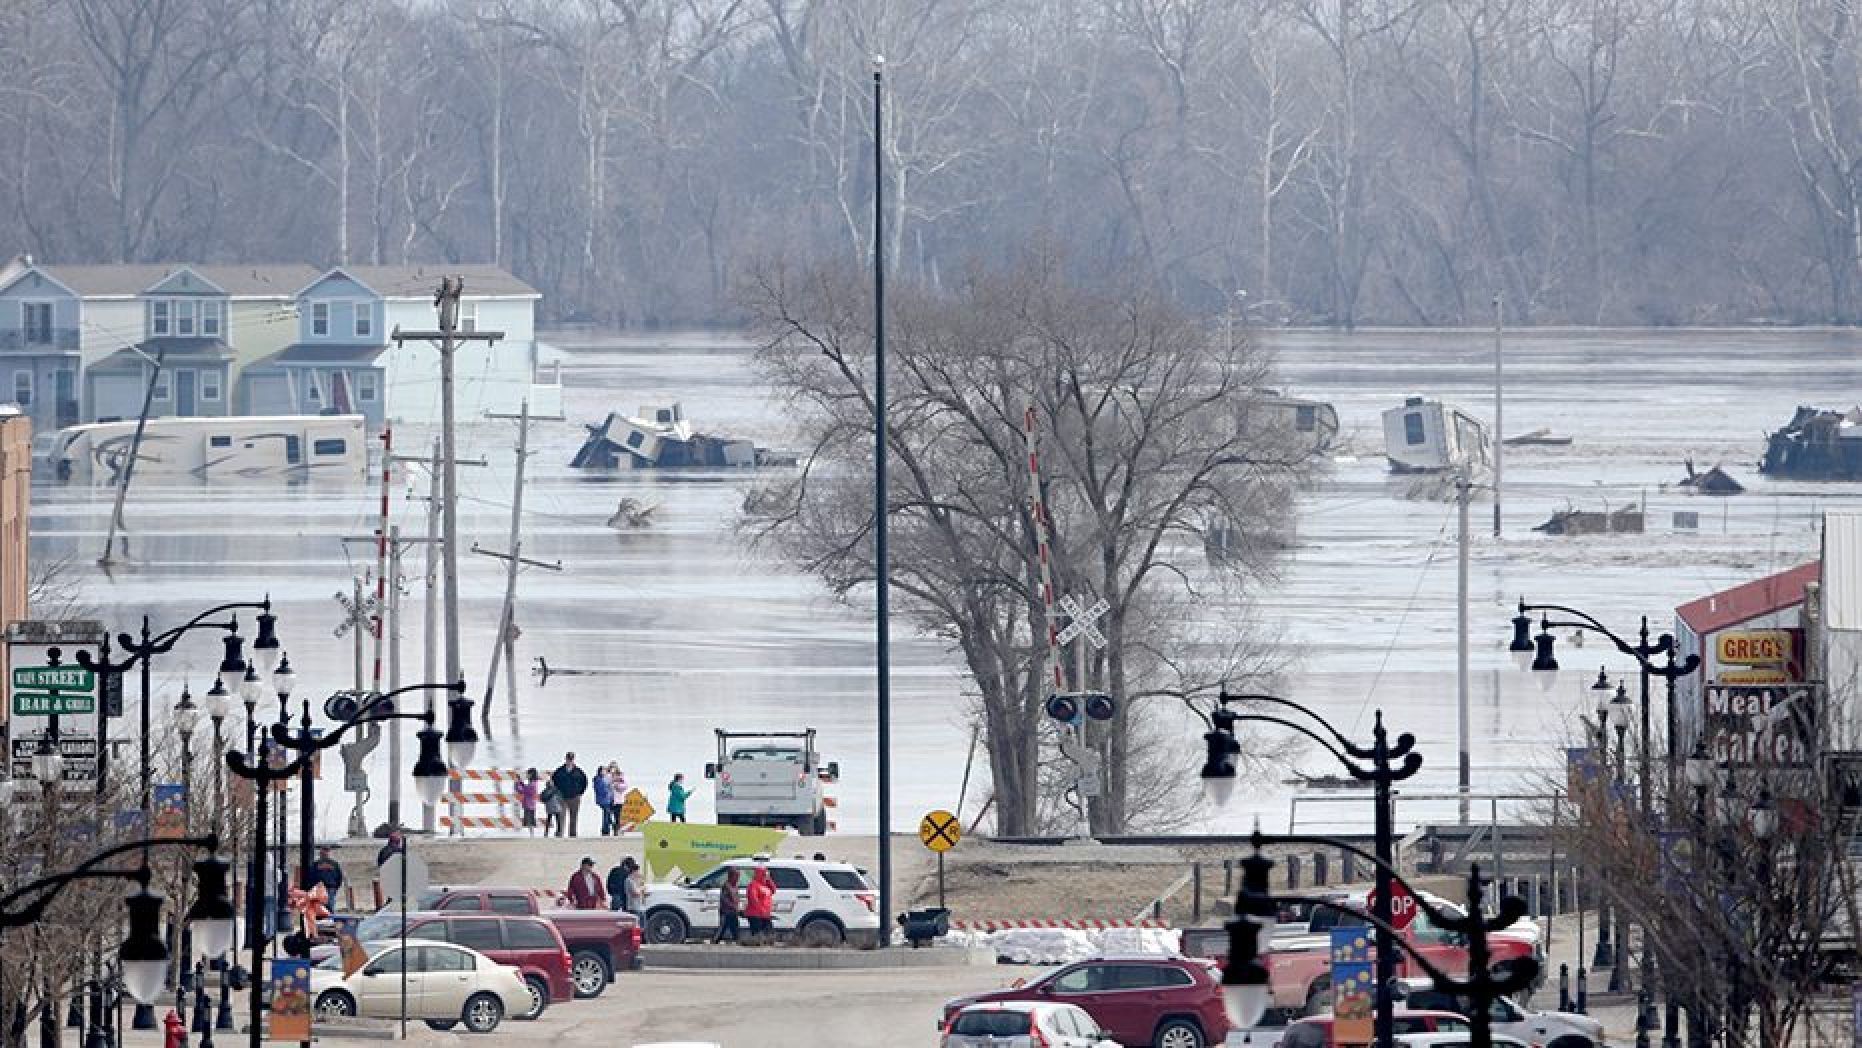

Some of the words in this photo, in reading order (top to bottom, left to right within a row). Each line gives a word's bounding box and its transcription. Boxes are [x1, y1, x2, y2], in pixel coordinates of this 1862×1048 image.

[37, 669, 87, 686] STREET
[20, 697, 50, 711] BAR
[53, 697, 63, 711] &
[1708, 689, 1771, 715] Meat
